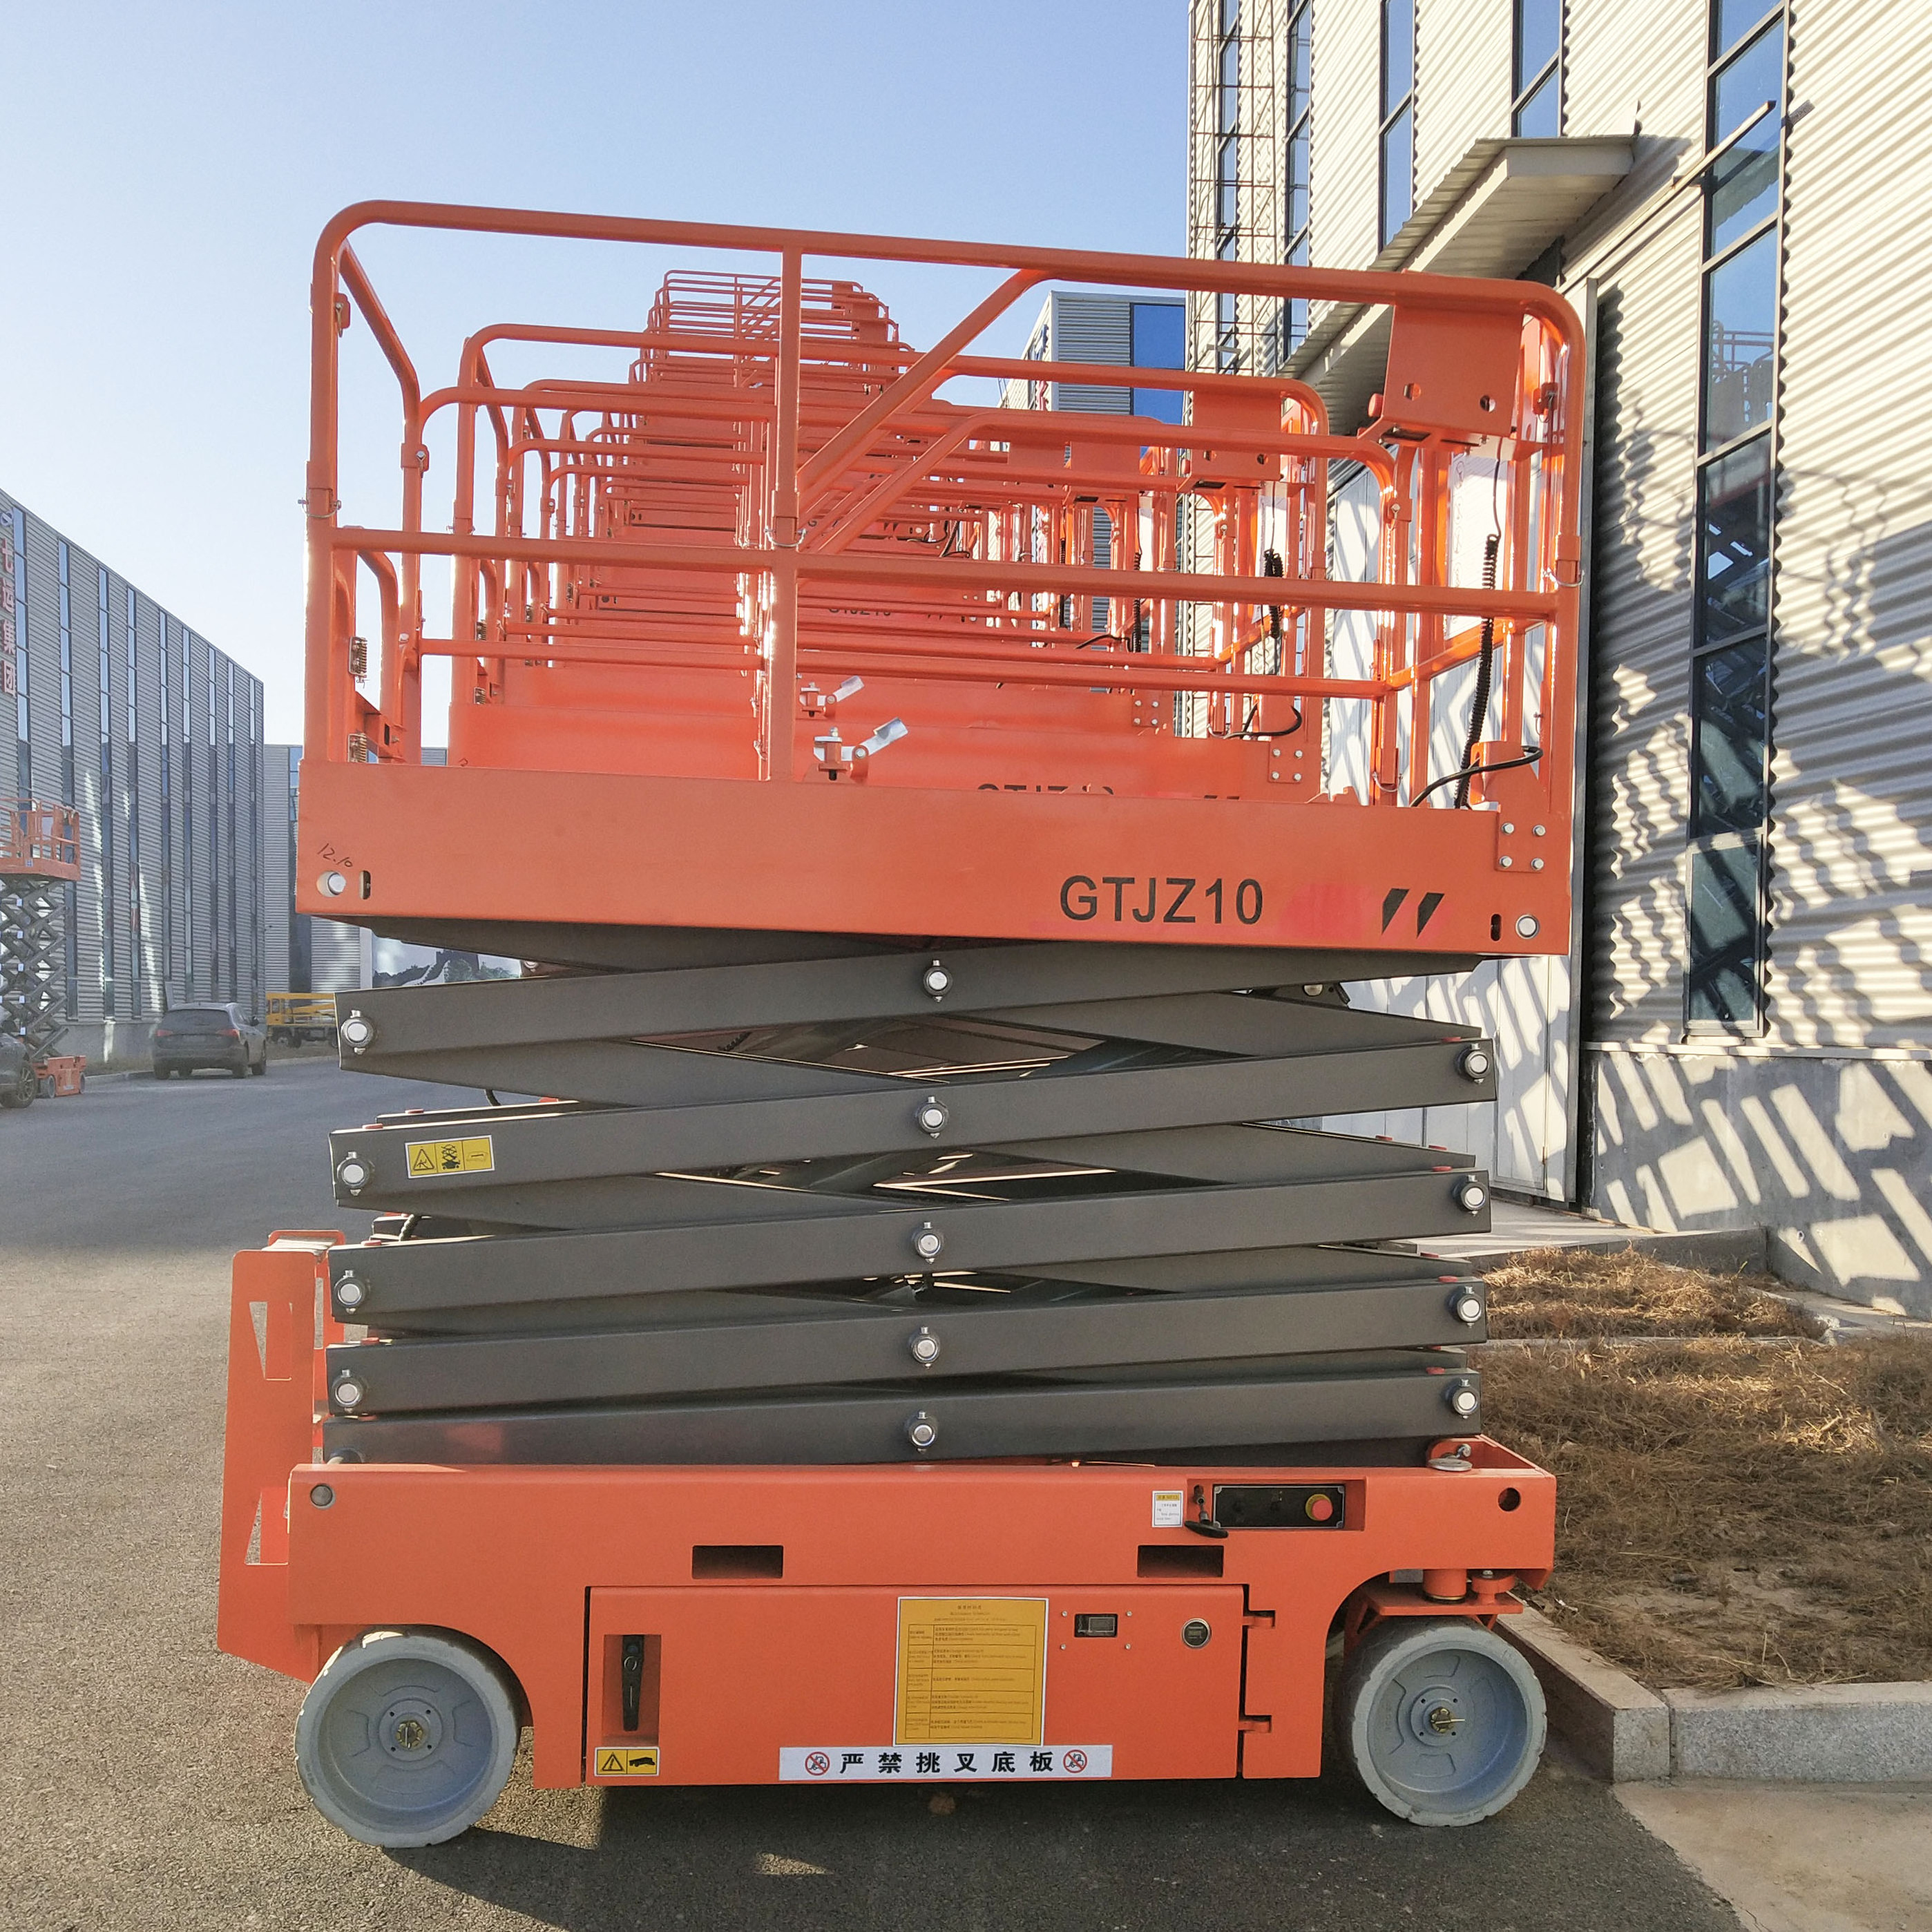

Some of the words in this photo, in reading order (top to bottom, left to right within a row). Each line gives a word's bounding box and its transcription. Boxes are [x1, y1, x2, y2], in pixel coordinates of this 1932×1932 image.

[1060, 874, 1263, 925] GTJZ10
[839, 1751, 1054, 1774] 严禁挑叉底板
